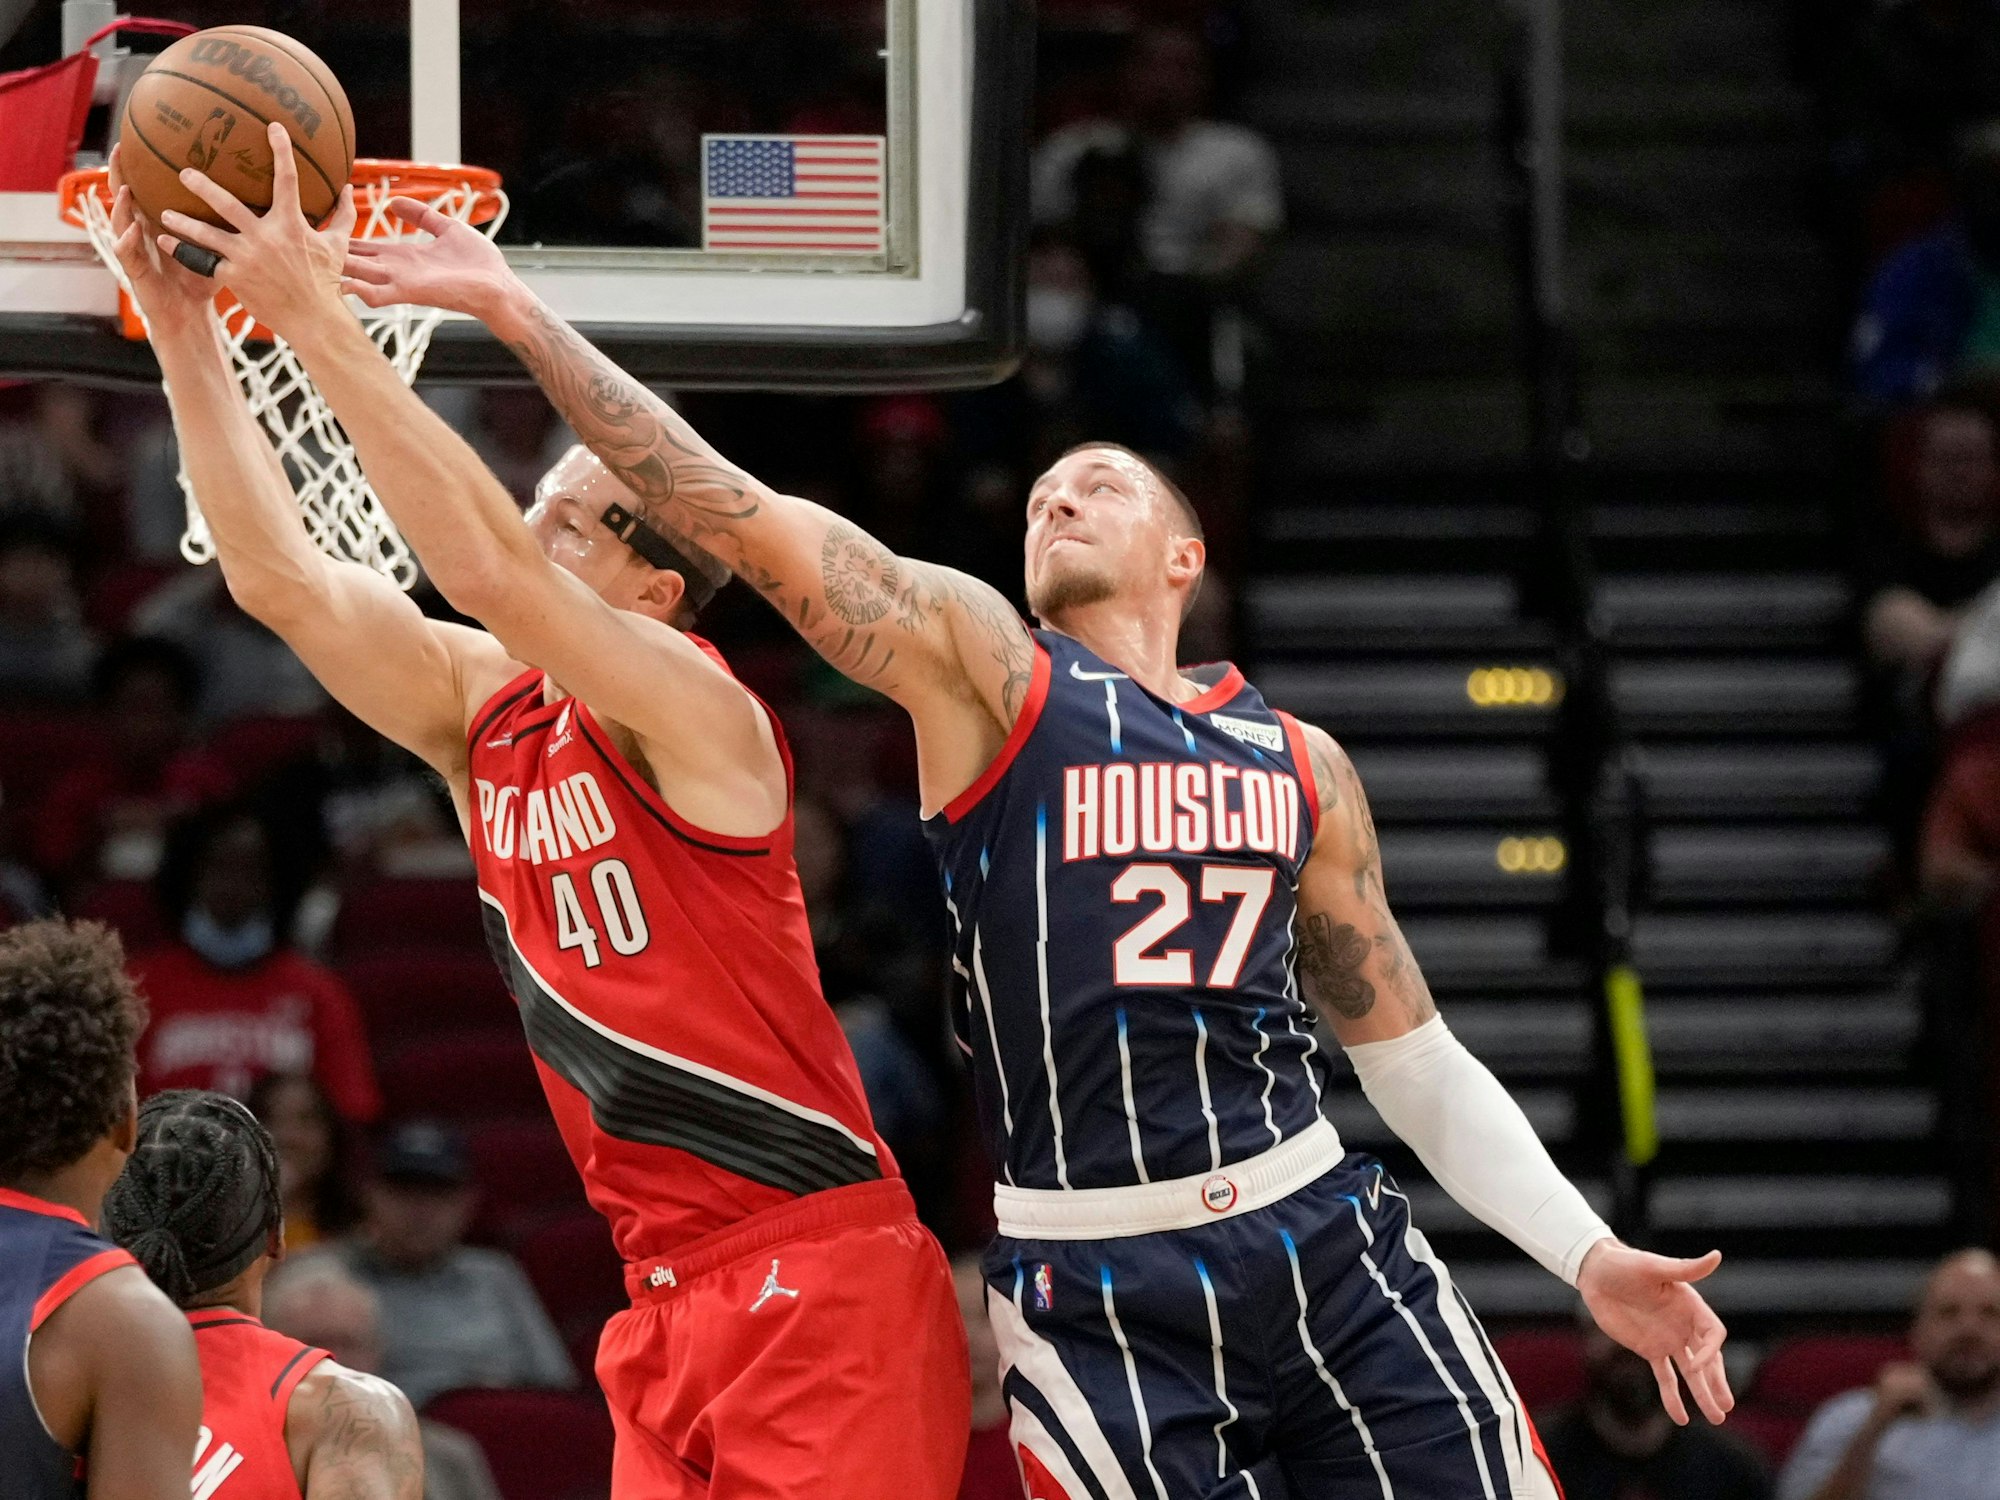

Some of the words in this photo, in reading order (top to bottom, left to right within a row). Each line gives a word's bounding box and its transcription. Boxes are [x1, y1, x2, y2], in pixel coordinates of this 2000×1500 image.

[189, 38, 322, 141] Wilson
[1218, 724, 1276, 747] MONEY
[550, 857, 650, 969] 40
[1109, 862, 1277, 989] 27
